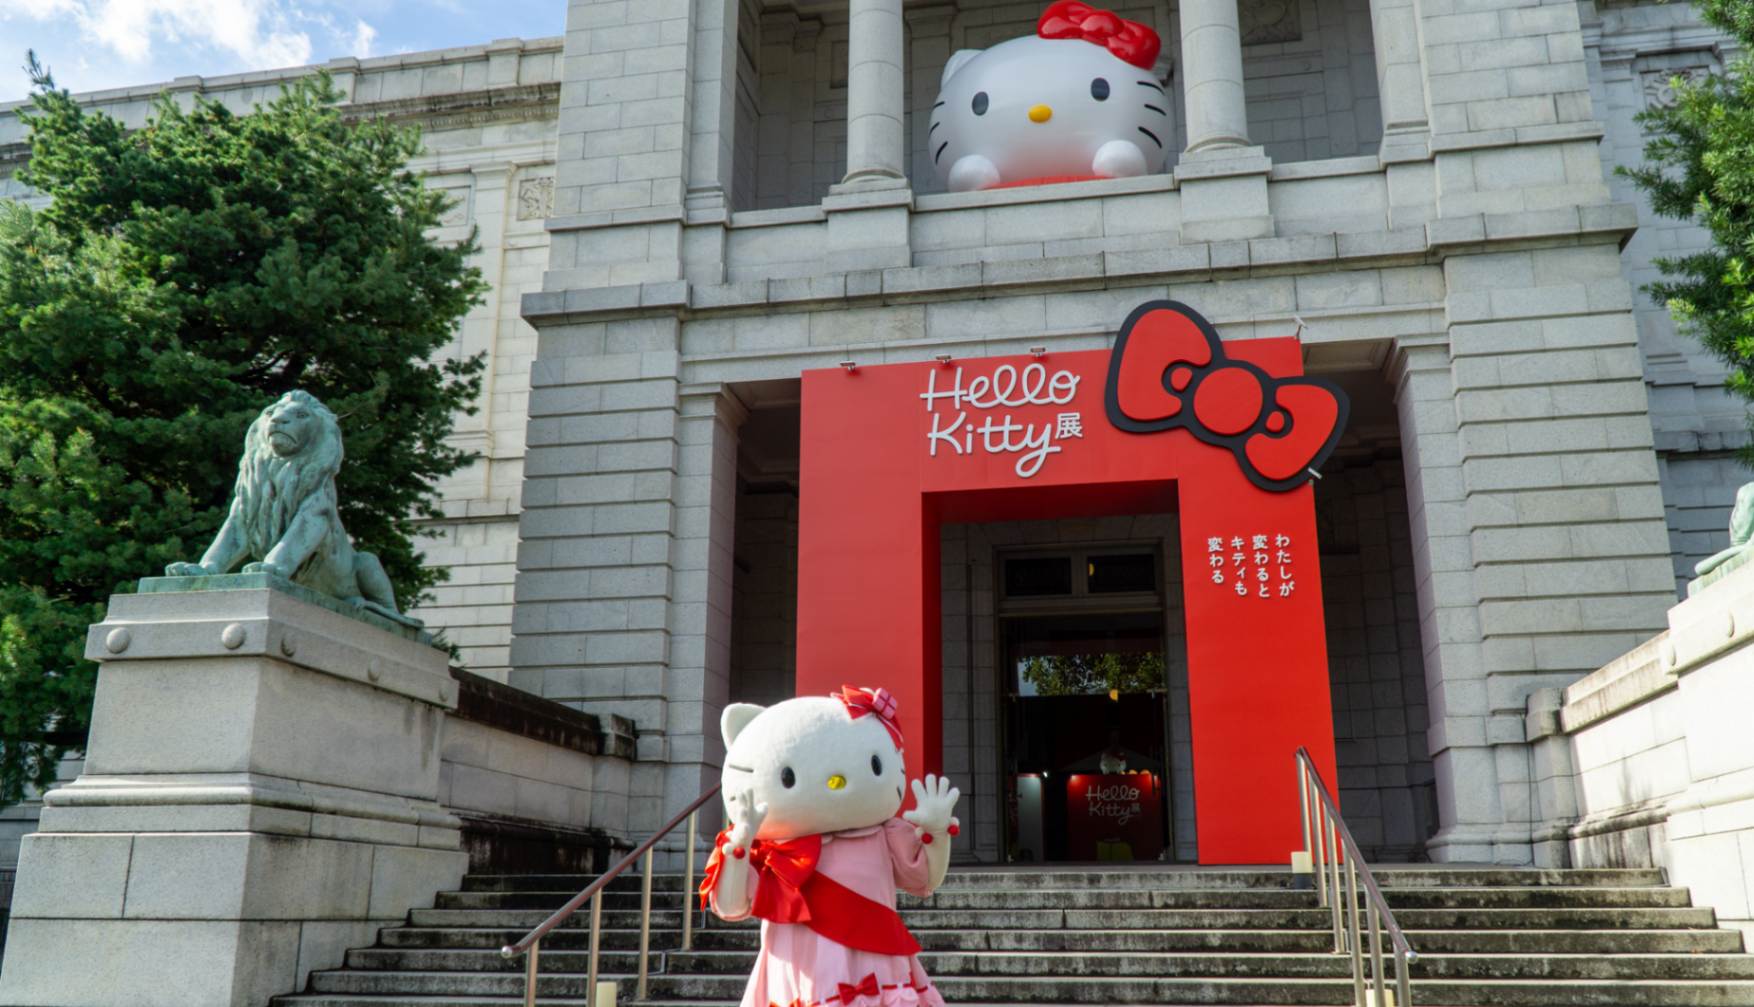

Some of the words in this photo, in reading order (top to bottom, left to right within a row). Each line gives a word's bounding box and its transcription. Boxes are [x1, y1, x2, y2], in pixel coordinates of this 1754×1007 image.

[920, 363, 1080, 411] Hello
[1208, 536, 1224, 584] 変わる
[1231, 535, 1248, 596] キティも
[1252, 534, 1270, 598] 変わると
[1275, 533, 1295, 597] わたしが
[1085, 784, 1141, 801] Hello
